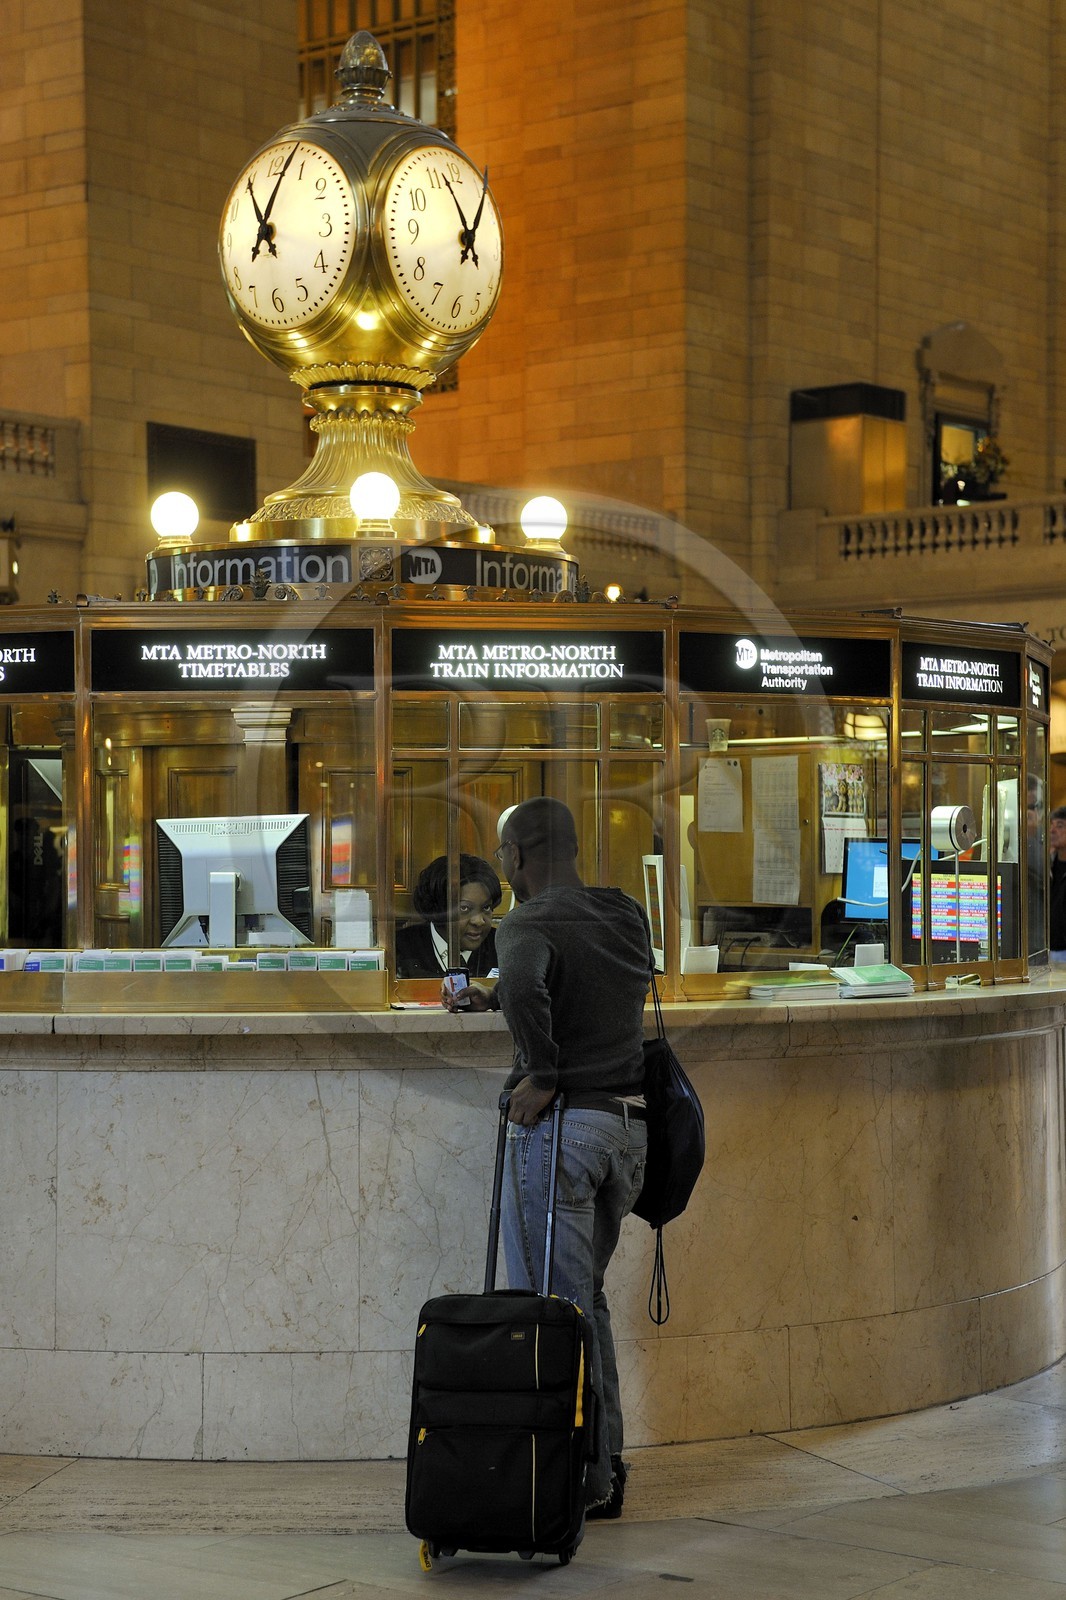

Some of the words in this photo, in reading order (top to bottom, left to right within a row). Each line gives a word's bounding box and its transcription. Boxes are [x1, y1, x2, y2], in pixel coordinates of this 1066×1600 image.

[267, 156, 285, 177] 12
[298, 160, 306, 180] 1
[426, 167, 442, 189] 11
[446, 162, 463, 184] 12
[314, 178, 327, 200] 2
[409, 188, 427, 211] 10
[318, 213, 333, 237] 3
[407, 218, 420, 245] 9
[313, 249, 329, 273] 4
[413, 256, 426, 281] 8
[233, 266, 242, 290] 8
[295, 277, 309, 302] 5
[249, 285, 258, 308] 7
[271, 288, 285, 313] 6
[431, 282, 444, 305] 7
[470, 292, 481, 315] 5
[451, 294, 464, 318] 6
[171, 546, 350, 590] Information
[407, 553, 437, 578] MTA
[140, 645, 182, 661] MTA
[186, 643, 327, 660] METRO-NORTH
[438, 644, 478, 660] MTA
[482, 644, 616, 660] METRO-NORTH
[760, 648, 823, 664] Metropolitan
[178, 662, 290, 679] TIMETABLES
[430, 662, 490, 679] TRAIN
[493, 662, 624, 679] INFORMATION
[760, 662, 834, 677] Transportation
[920, 656, 940, 672] MTA
[939, 658, 1000, 677] METRO-NORTH
[761, 676, 807, 691] Authority
[916, 673, 944, 688] TRAIN
[945, 676, 1003, 693] INFORMATION
[33, 832, 44, 865] DELL
